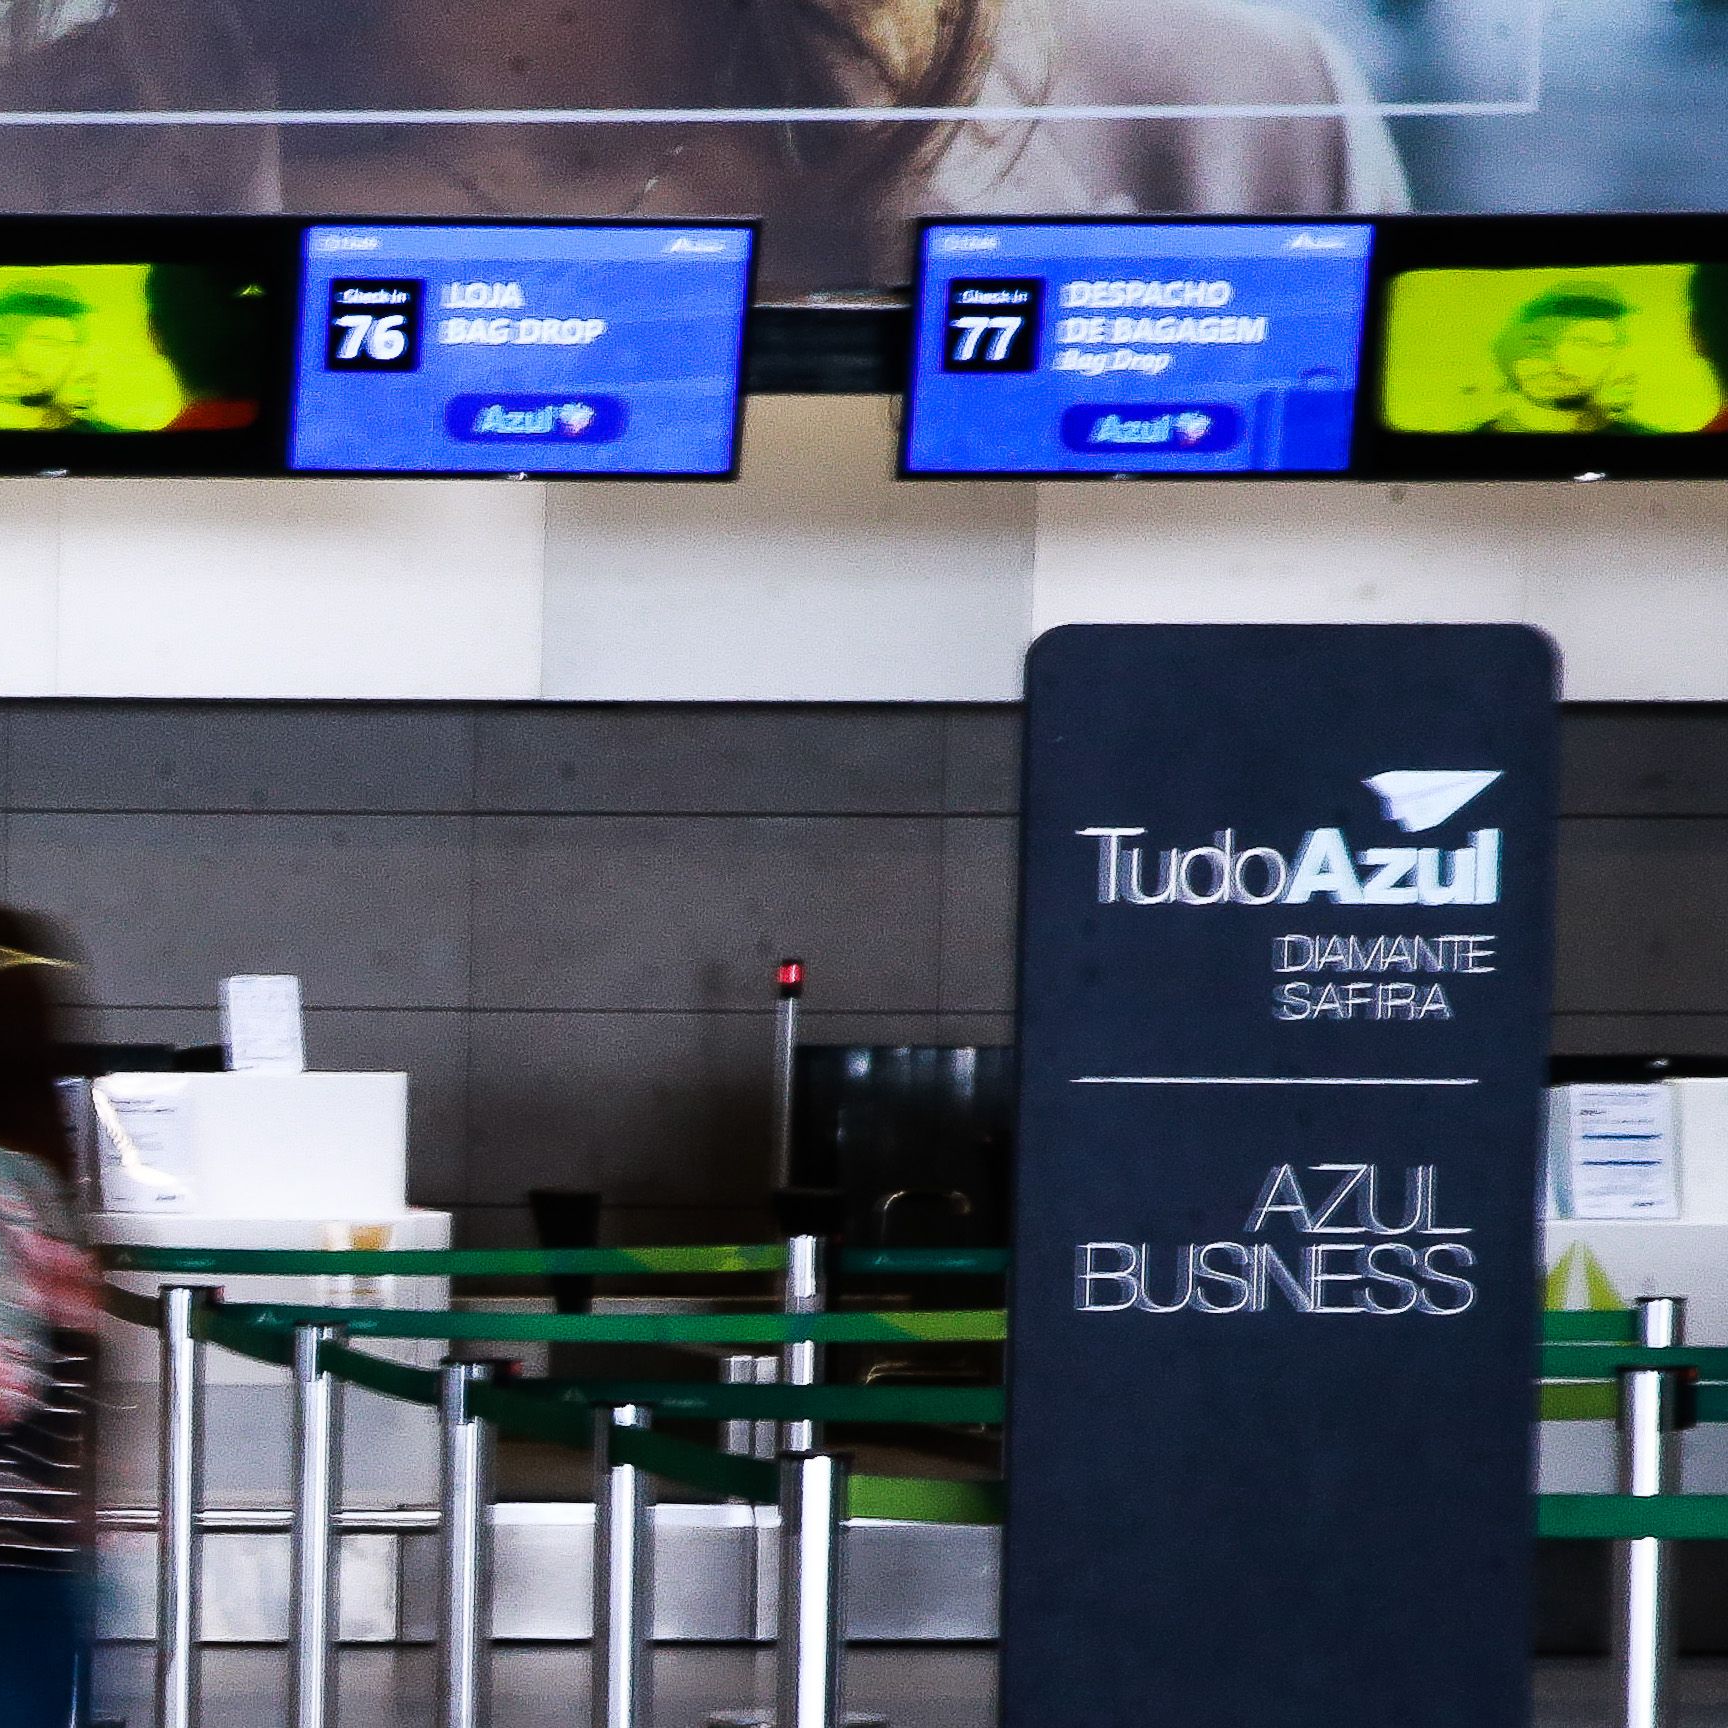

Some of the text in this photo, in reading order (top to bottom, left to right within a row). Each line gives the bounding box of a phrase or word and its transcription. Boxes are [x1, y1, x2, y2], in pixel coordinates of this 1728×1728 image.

[442, 282, 525, 308] LOJA
[1058, 279, 1234, 307] DESPACHO
[332, 315, 407, 360] 76
[439, 318, 606, 344] BAG DROP
[950, 317, 1023, 361] 77
[1054, 317, 1268, 343] DE BAGAGEM
[1053, 349, 1106, 376] Bag
[472, 404, 555, 434] Azul
[1273, 934, 1497, 973] DIAMANTE
[1272, 981, 1453, 1020] SAFIRA
[1245, 1164, 1474, 1235] AZUL
[1074, 1242, 1476, 1315] BUSINESS
